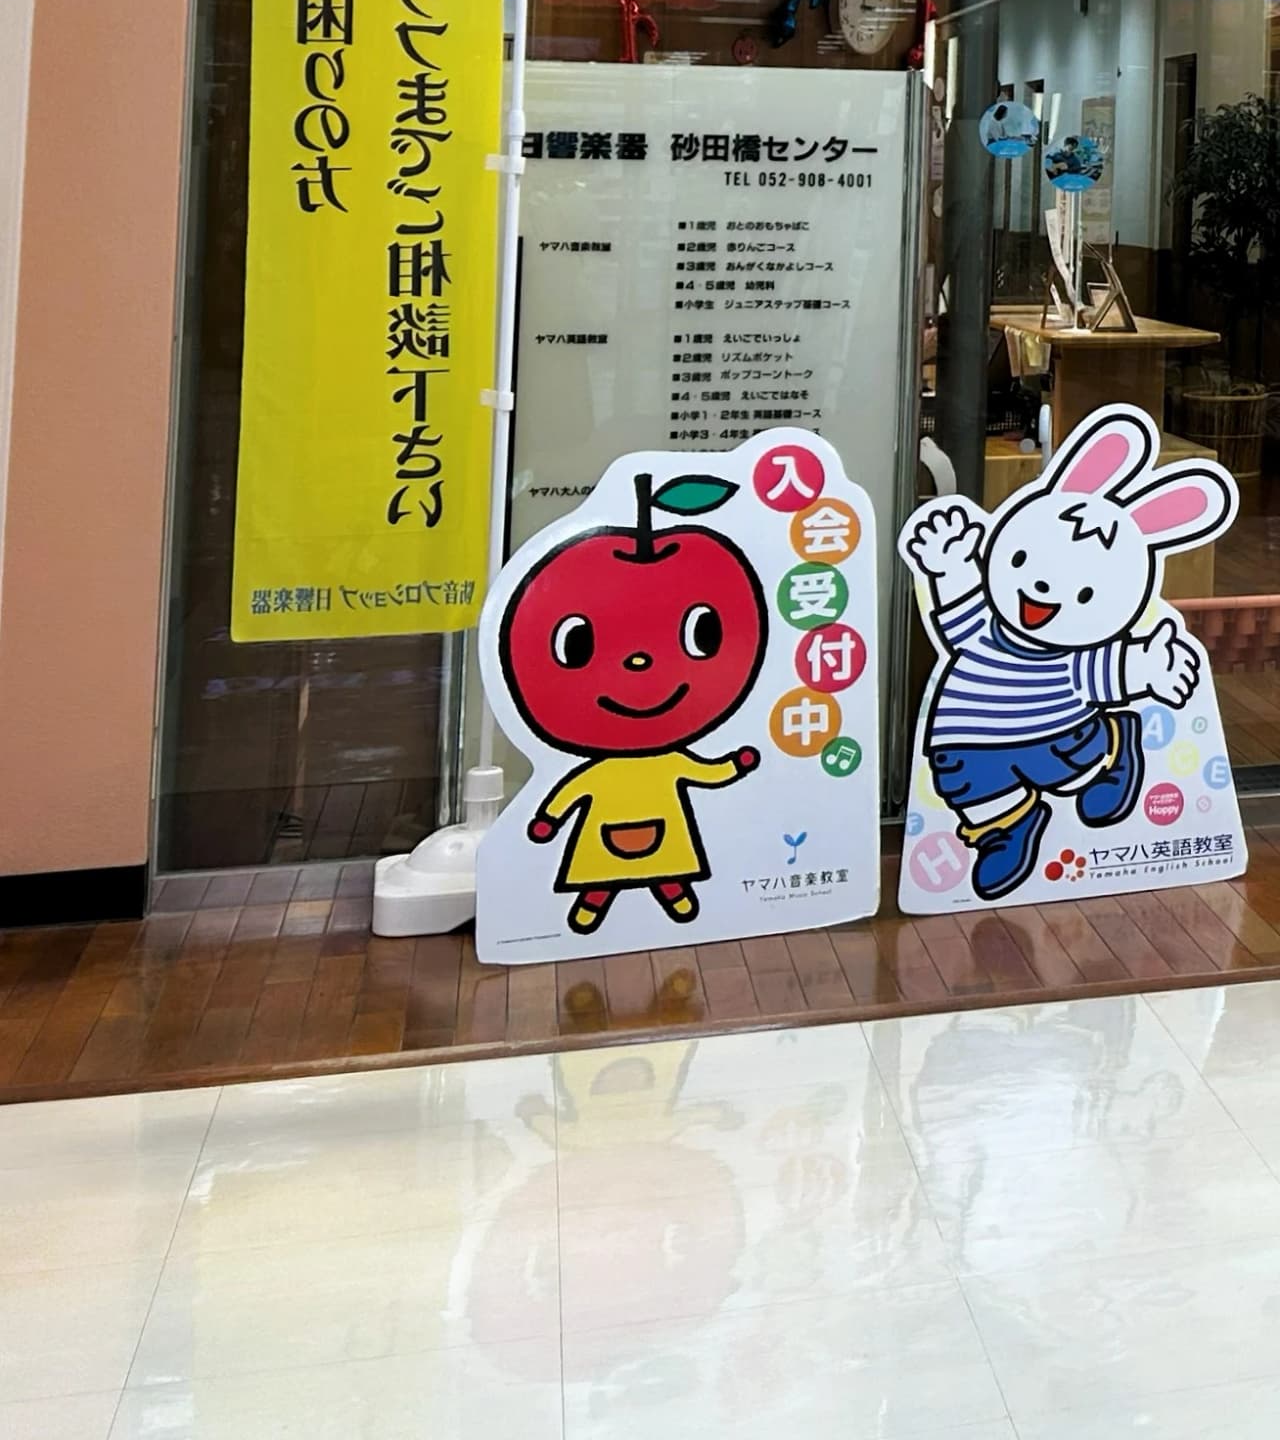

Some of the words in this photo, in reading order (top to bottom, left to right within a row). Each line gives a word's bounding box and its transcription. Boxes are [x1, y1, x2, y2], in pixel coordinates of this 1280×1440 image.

[671, 133, 878, 162] 砂田橋センター
[724, 172, 751, 187] TEL
[758, 172, 873, 188] 052-908-4001
[529, 486, 597, 497] ヤマハ大人の
[766, 456, 857, 746] 入会受付中
[1089, 834, 1233, 865] ヤマハ英語教室
[1089, 868, 1137, 879] Yamaha
[1144, 862, 1188, 875] English
[1195, 856, 1234, 867] School
[741, 869, 849, 892] ヤマハ音楽教室
